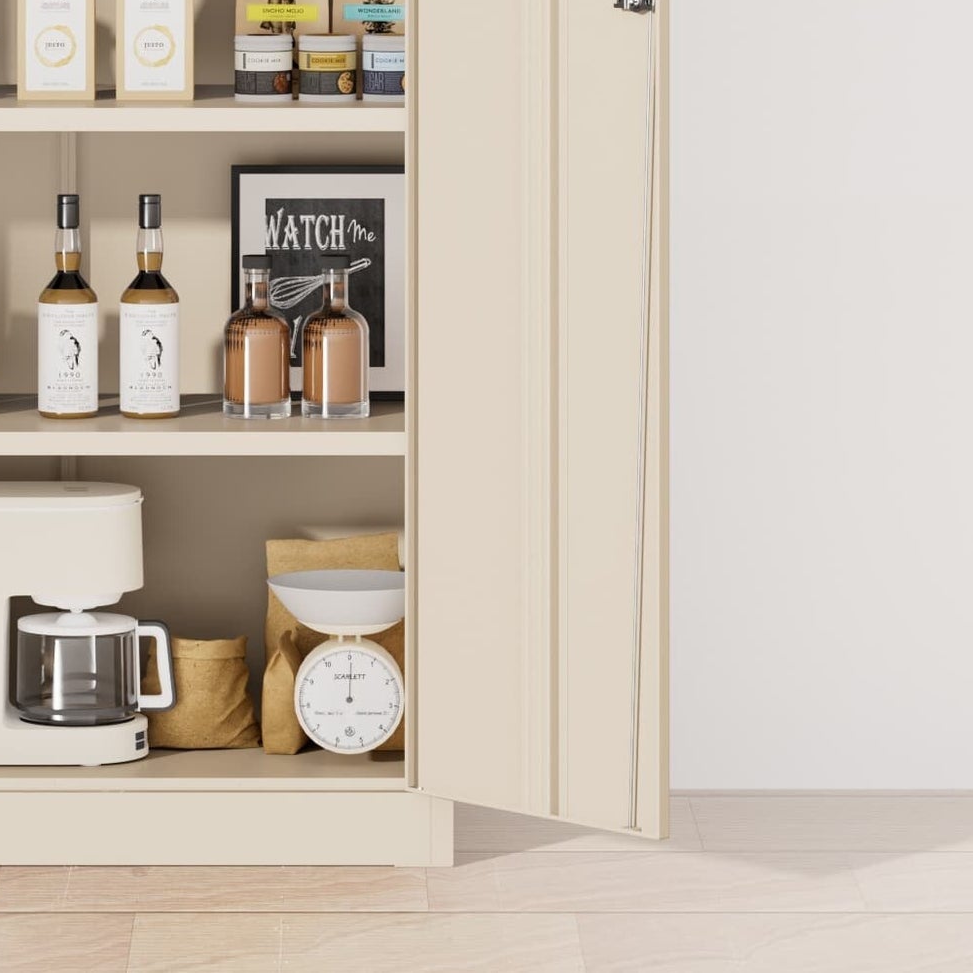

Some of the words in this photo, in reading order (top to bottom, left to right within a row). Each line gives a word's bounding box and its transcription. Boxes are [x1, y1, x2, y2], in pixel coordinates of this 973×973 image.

[265, 207, 346, 251] WATCH
[347, 219, 377, 243] Me
[58, 371, 81, 379] 1990
